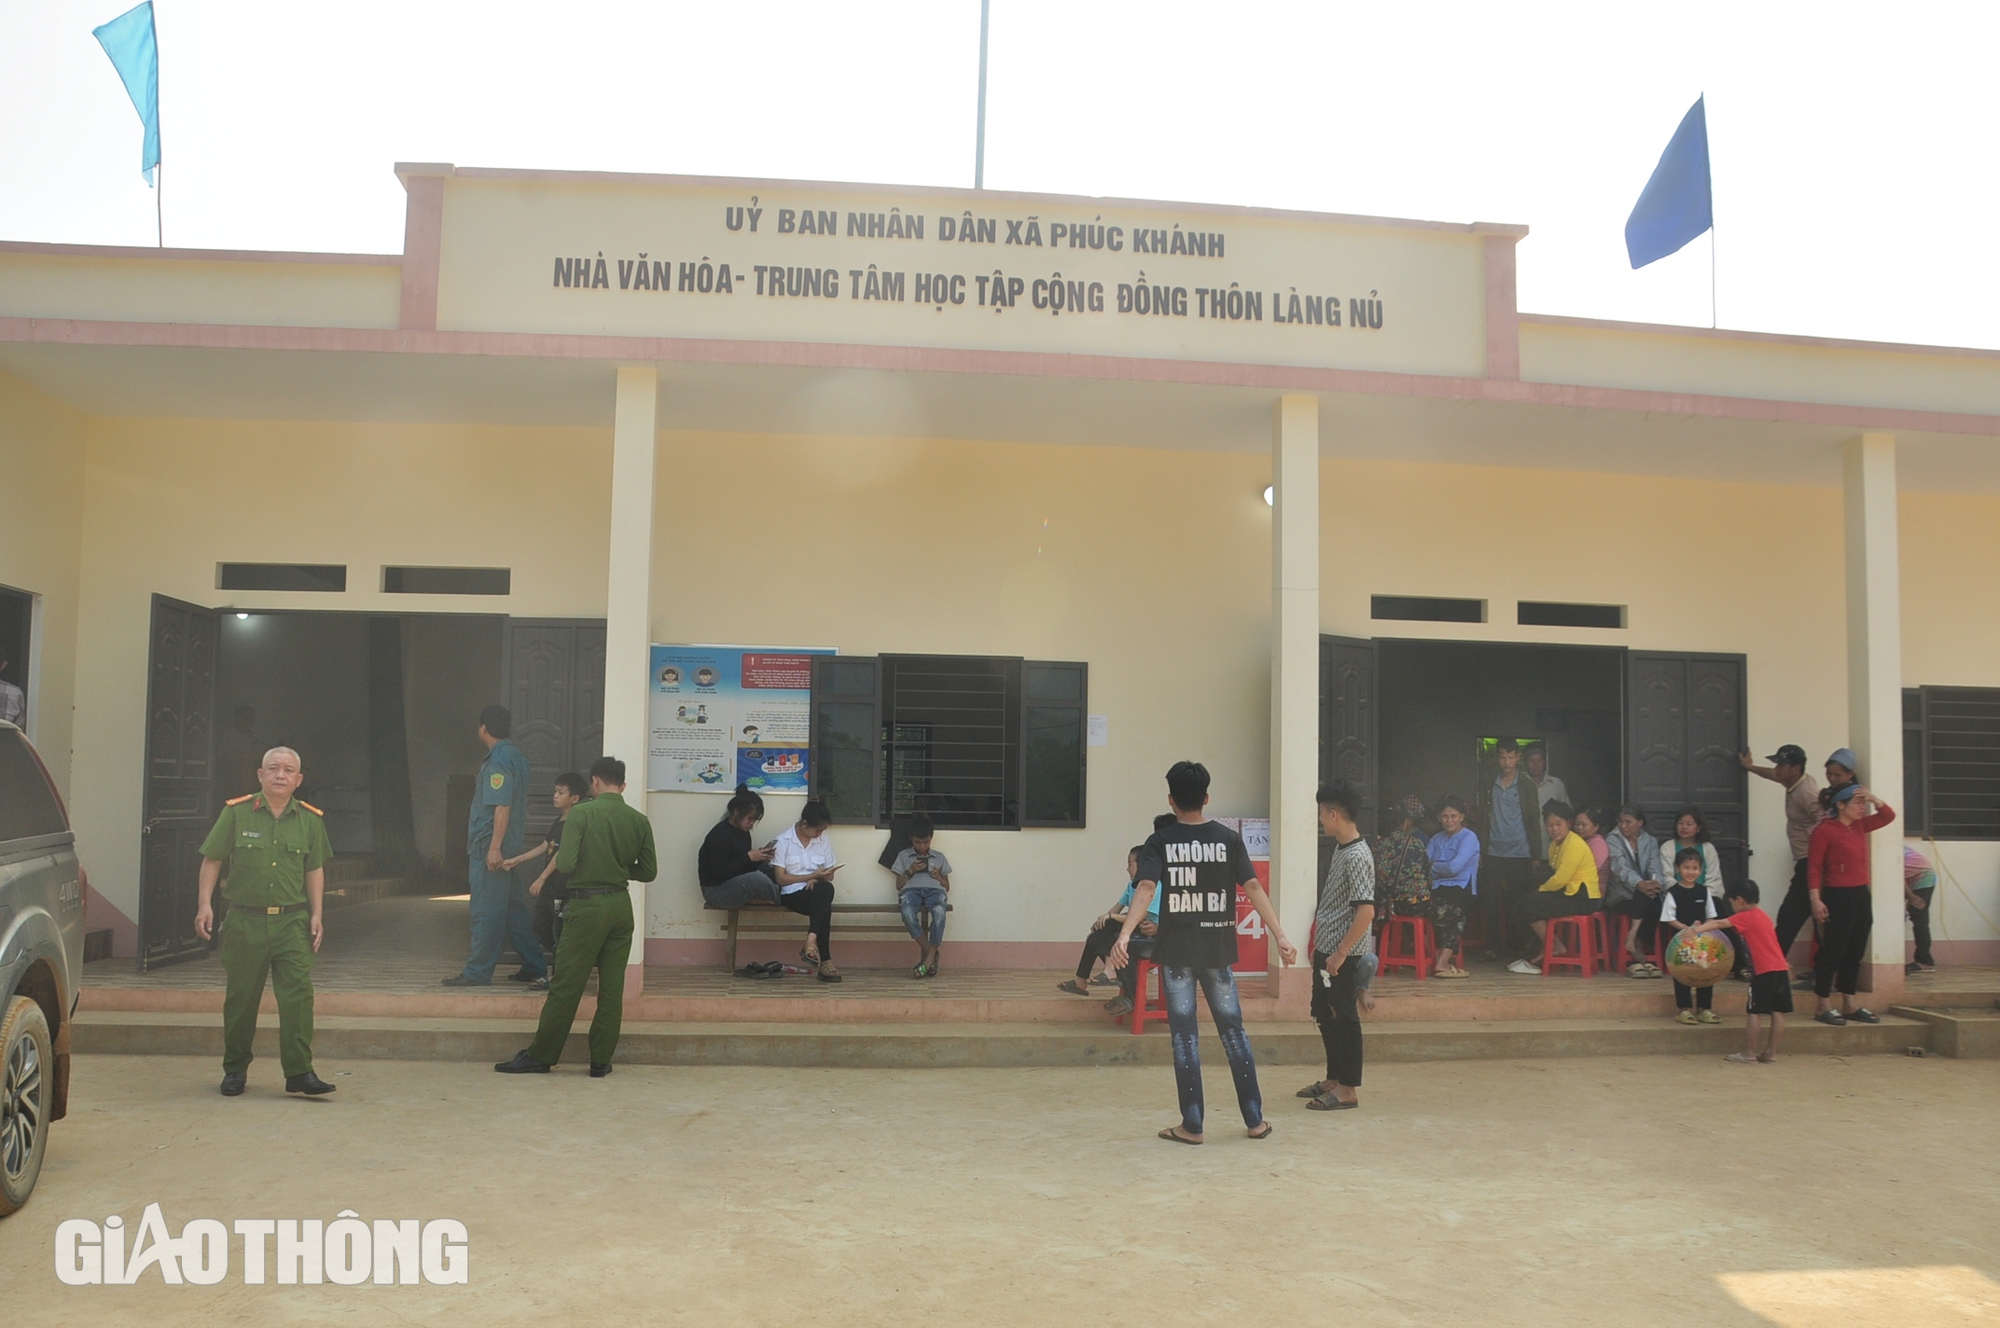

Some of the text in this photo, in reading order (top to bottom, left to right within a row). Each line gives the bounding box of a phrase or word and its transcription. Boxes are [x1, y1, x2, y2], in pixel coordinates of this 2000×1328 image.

[725, 195, 1225, 258] UỶ BAN NHÂN DÂN XÃ PHÚC KHÁNH
[553, 250, 609, 289] NHÀ
[617, 252, 671, 291] VĂN
[753, 265, 839, 298] TRUNG
[849, 263, 905, 302] TÂM
[914, 272, 966, 312] HỌC
[975, 269, 1025, 313] TẬP
[1032, 271, 1105, 316] CỘNG
[1117, 269, 1188, 316] ĐỒNG
[1195, 281, 1263, 321] THÔN
[1273, 286, 1342, 326] LÀNG
[1350, 289, 1384, 329] NỦ
[1165, 840, 1227, 863] KHÔNG
[1168, 866, 1197, 887] TIN
[1169, 889, 1203, 913] ĐÀN
